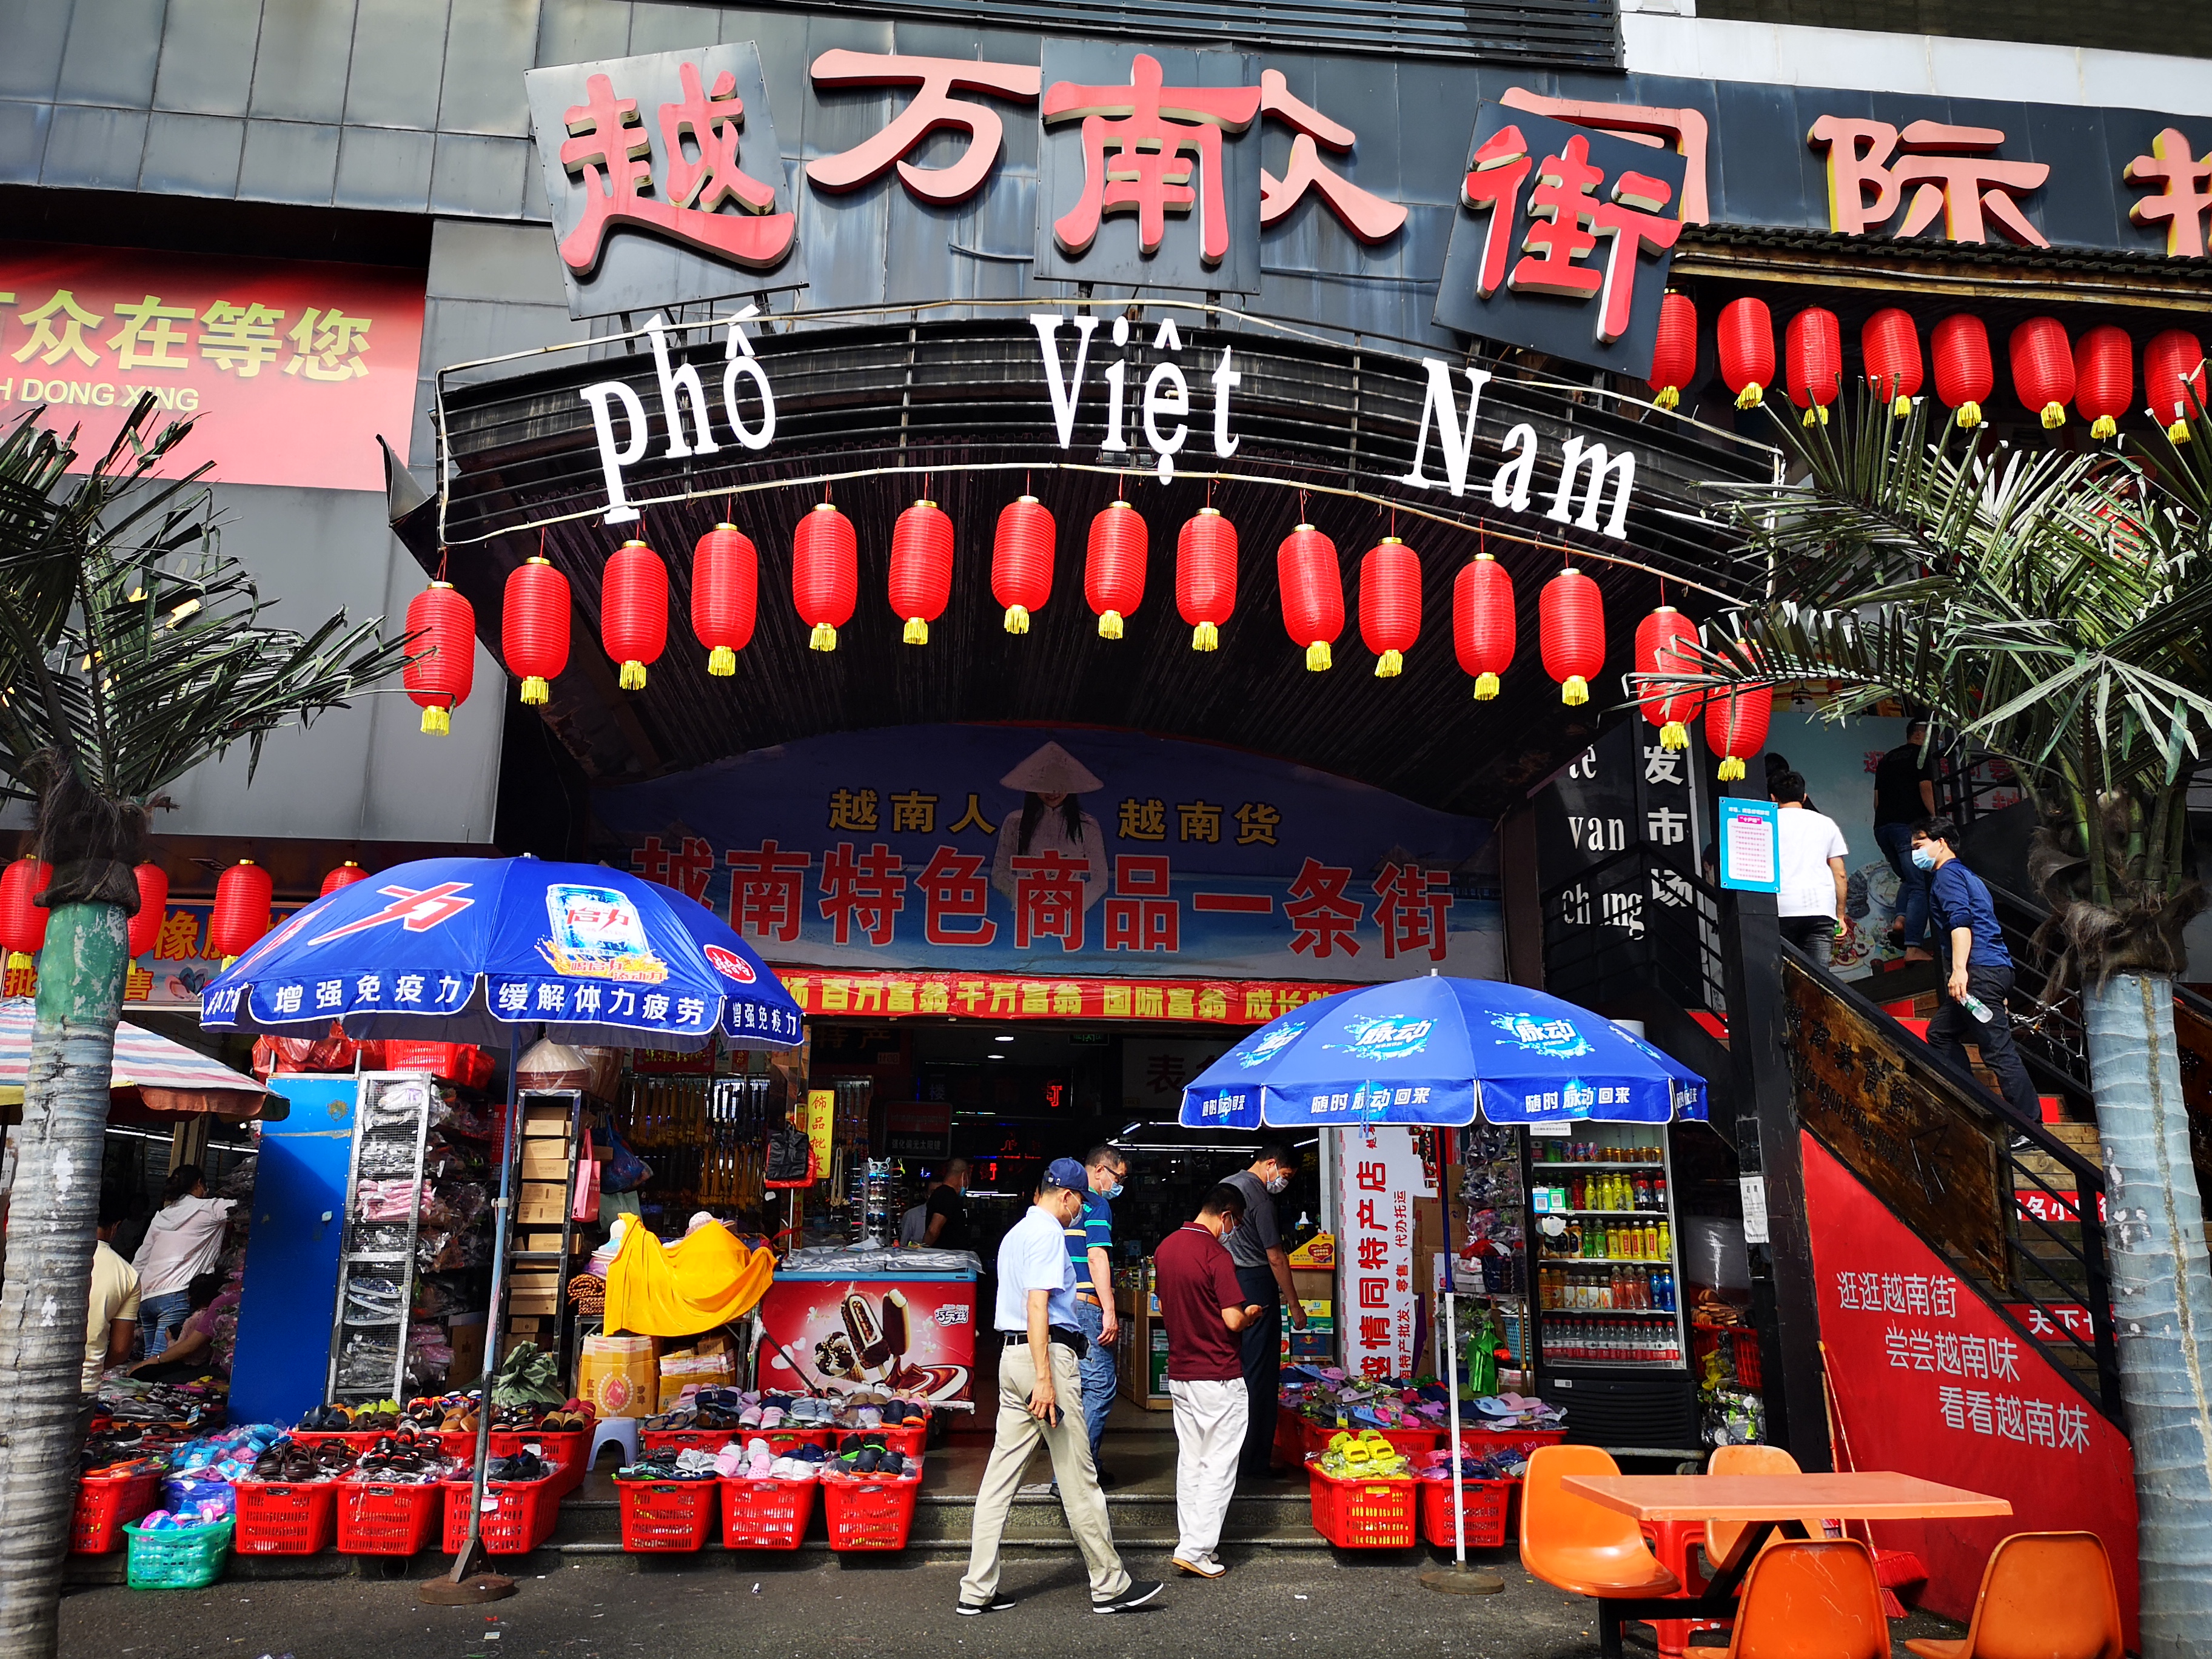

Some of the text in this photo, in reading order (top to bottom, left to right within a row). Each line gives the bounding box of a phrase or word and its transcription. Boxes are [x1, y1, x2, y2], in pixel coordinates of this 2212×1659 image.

[0, 289, 372, 381] 众在等您
[21, 378, 115, 406] DONG
[122, 384, 199, 411] XNG
[580, 304, 1636, 540] phố Việt Nam
[828, 789, 1282, 846] 越南人 越南货
[1568, 816, 1625, 851] van
[630, 837, 1454, 963] 越南特色商品一条街
[273, 974, 461, 1013] 增强免疫力
[498, 983, 705, 1025] 缓解体力疲劳
[821, 977, 950, 1013] 百万富翁
[954, 980, 1083, 1015] 千万富翁
[1102, 985, 1227, 1020] 国际富翁
[732, 1001, 797, 1036] 增强免疫力
[1515, 1020, 1577, 1043] 脉动
[1525, 1086, 1630, 1113] 随时脉动回来
[1837, 1272, 1957, 1319] 逛逛越南街
[1885, 1326, 2020, 1384] 尝尝越南味
[1939, 1386, 2091, 1454] 看看越南妹
